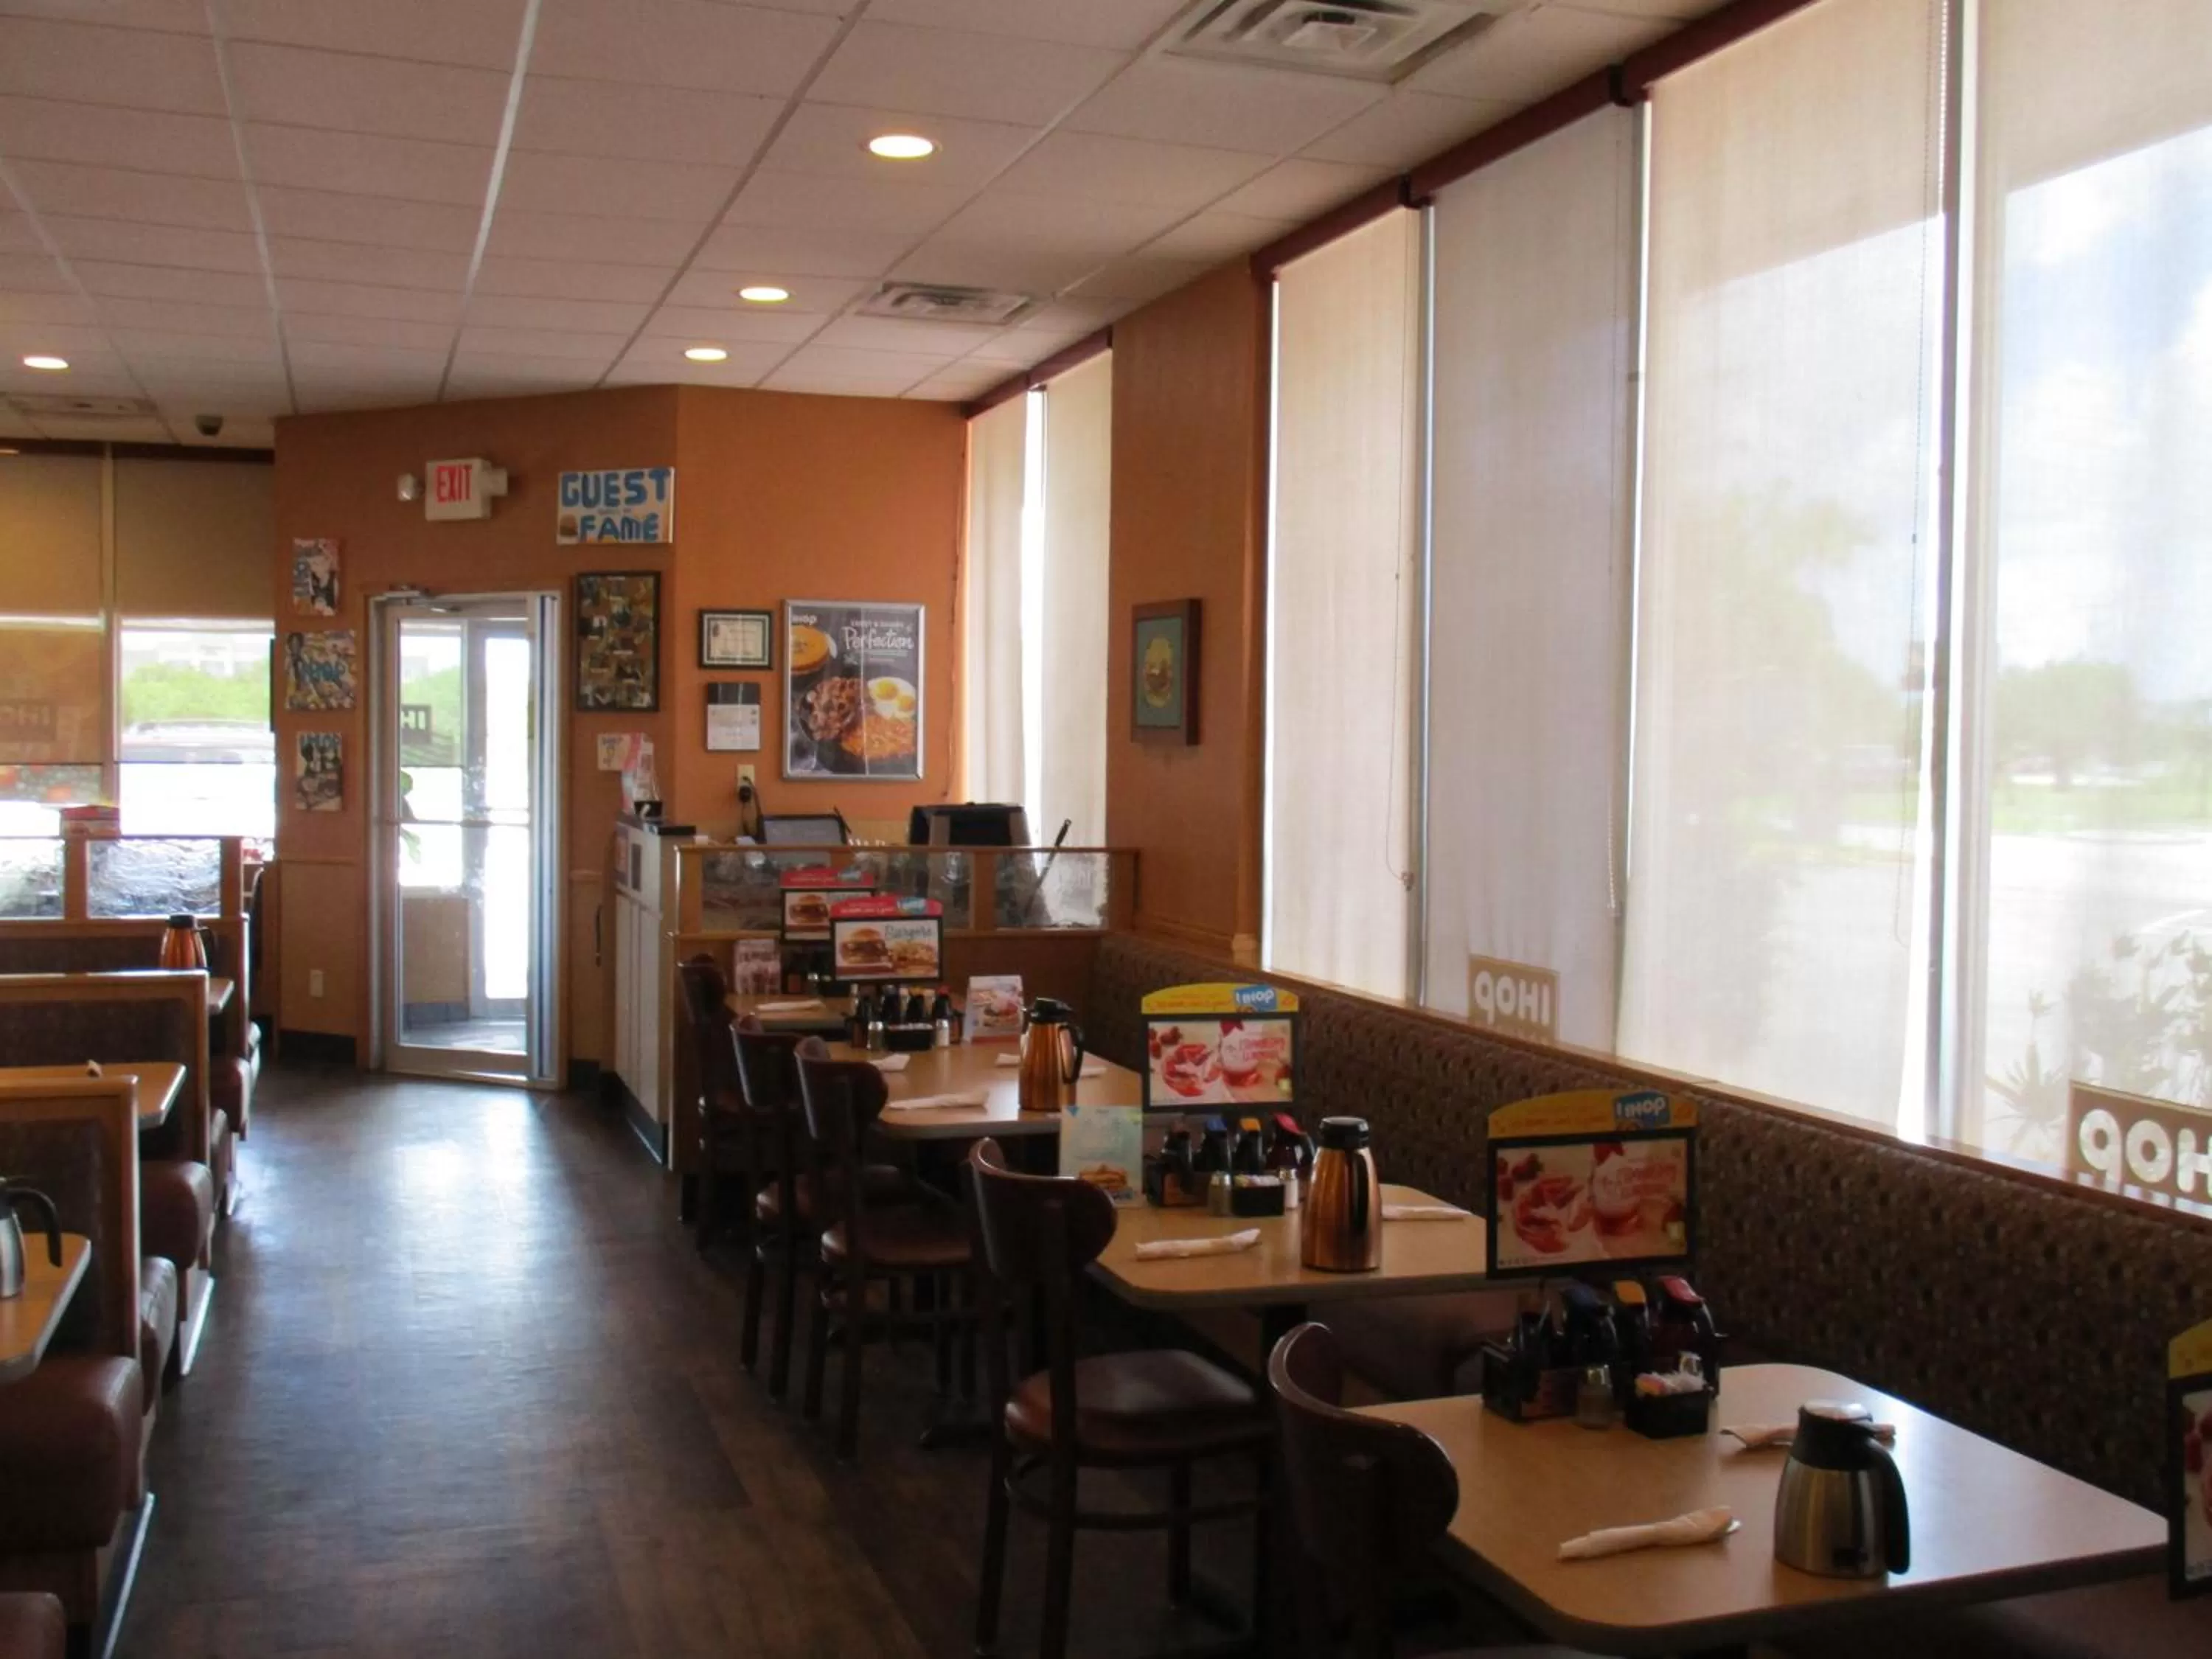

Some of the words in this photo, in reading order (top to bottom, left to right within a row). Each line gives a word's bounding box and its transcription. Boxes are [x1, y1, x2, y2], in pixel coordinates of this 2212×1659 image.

[435, 465, 472, 503] EXIT
[562, 466, 670, 509] GUEST
[580, 513, 658, 544] FAME
